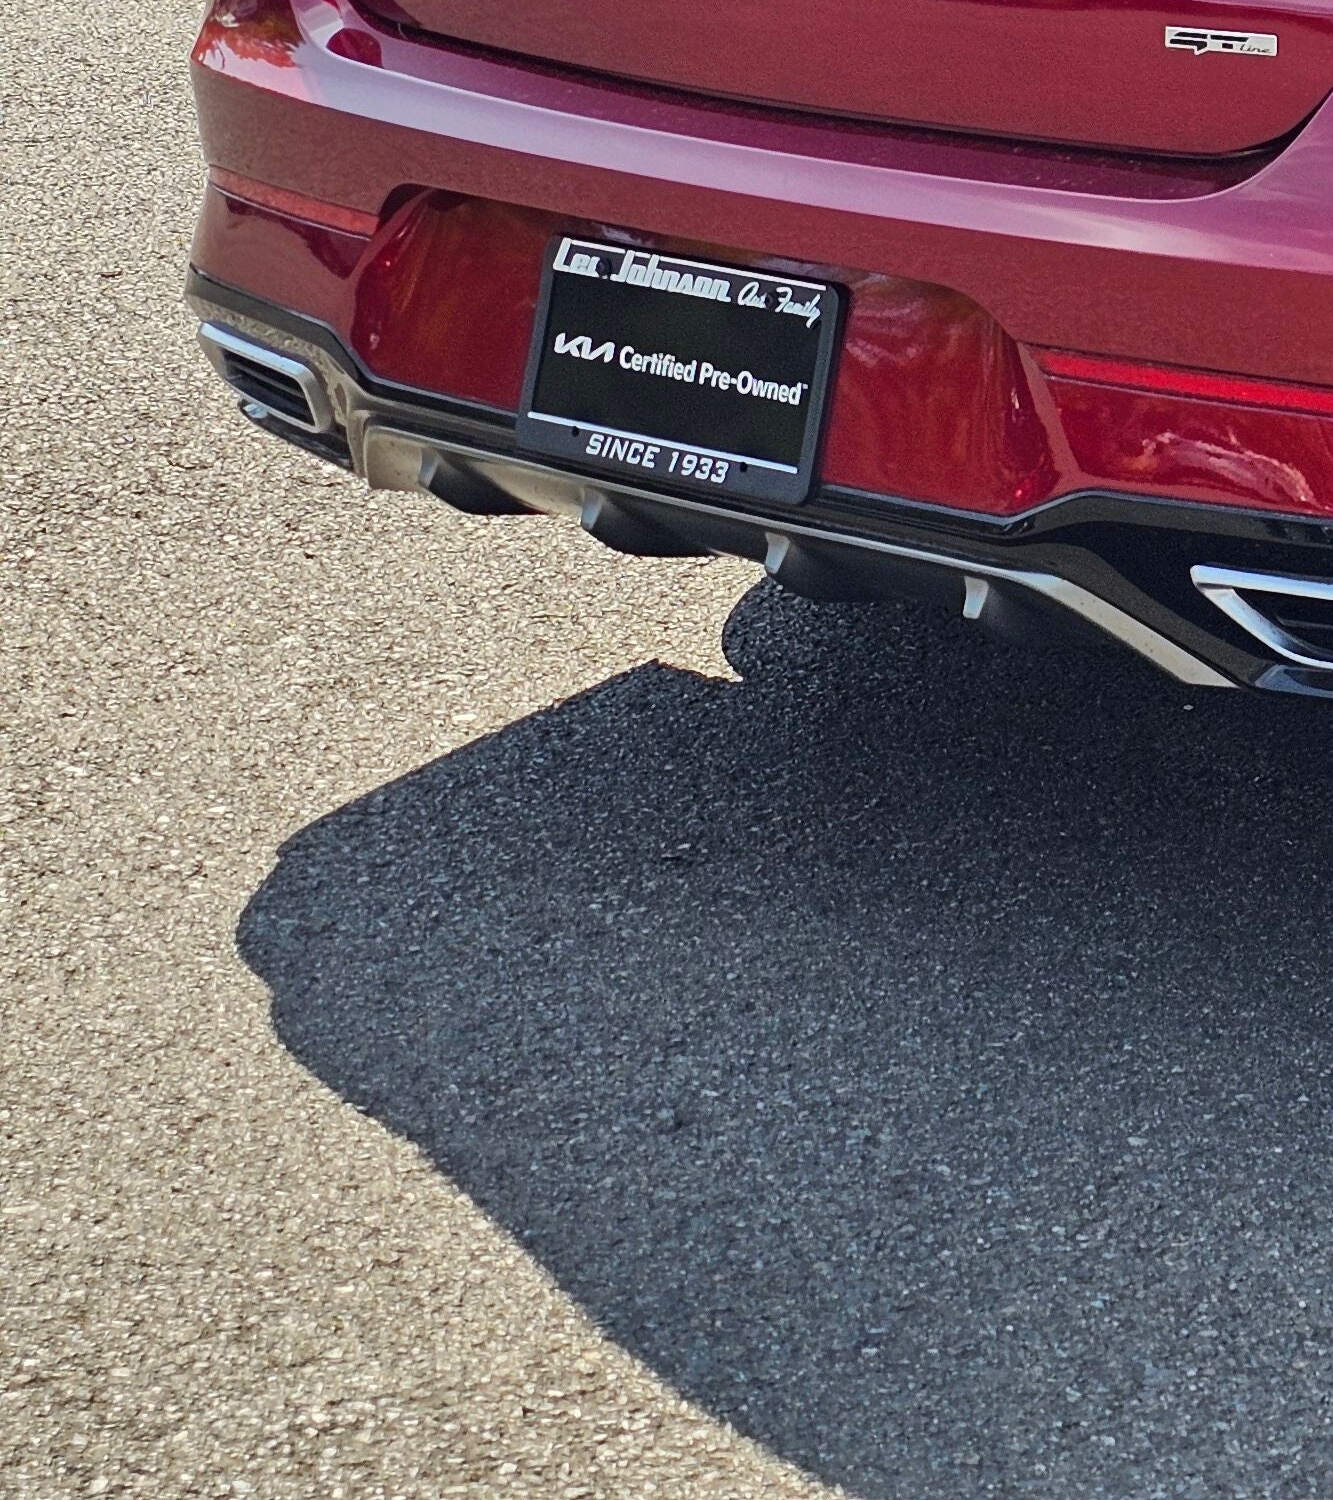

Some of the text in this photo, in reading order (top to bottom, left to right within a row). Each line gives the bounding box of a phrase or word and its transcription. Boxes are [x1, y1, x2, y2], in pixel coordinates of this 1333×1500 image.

[610, 249, 731, 303] Johnson
[553, 332, 616, 363] KIA
[619, 345, 698, 383] Certified
[585, 433, 730, 484] SINCE 1933
